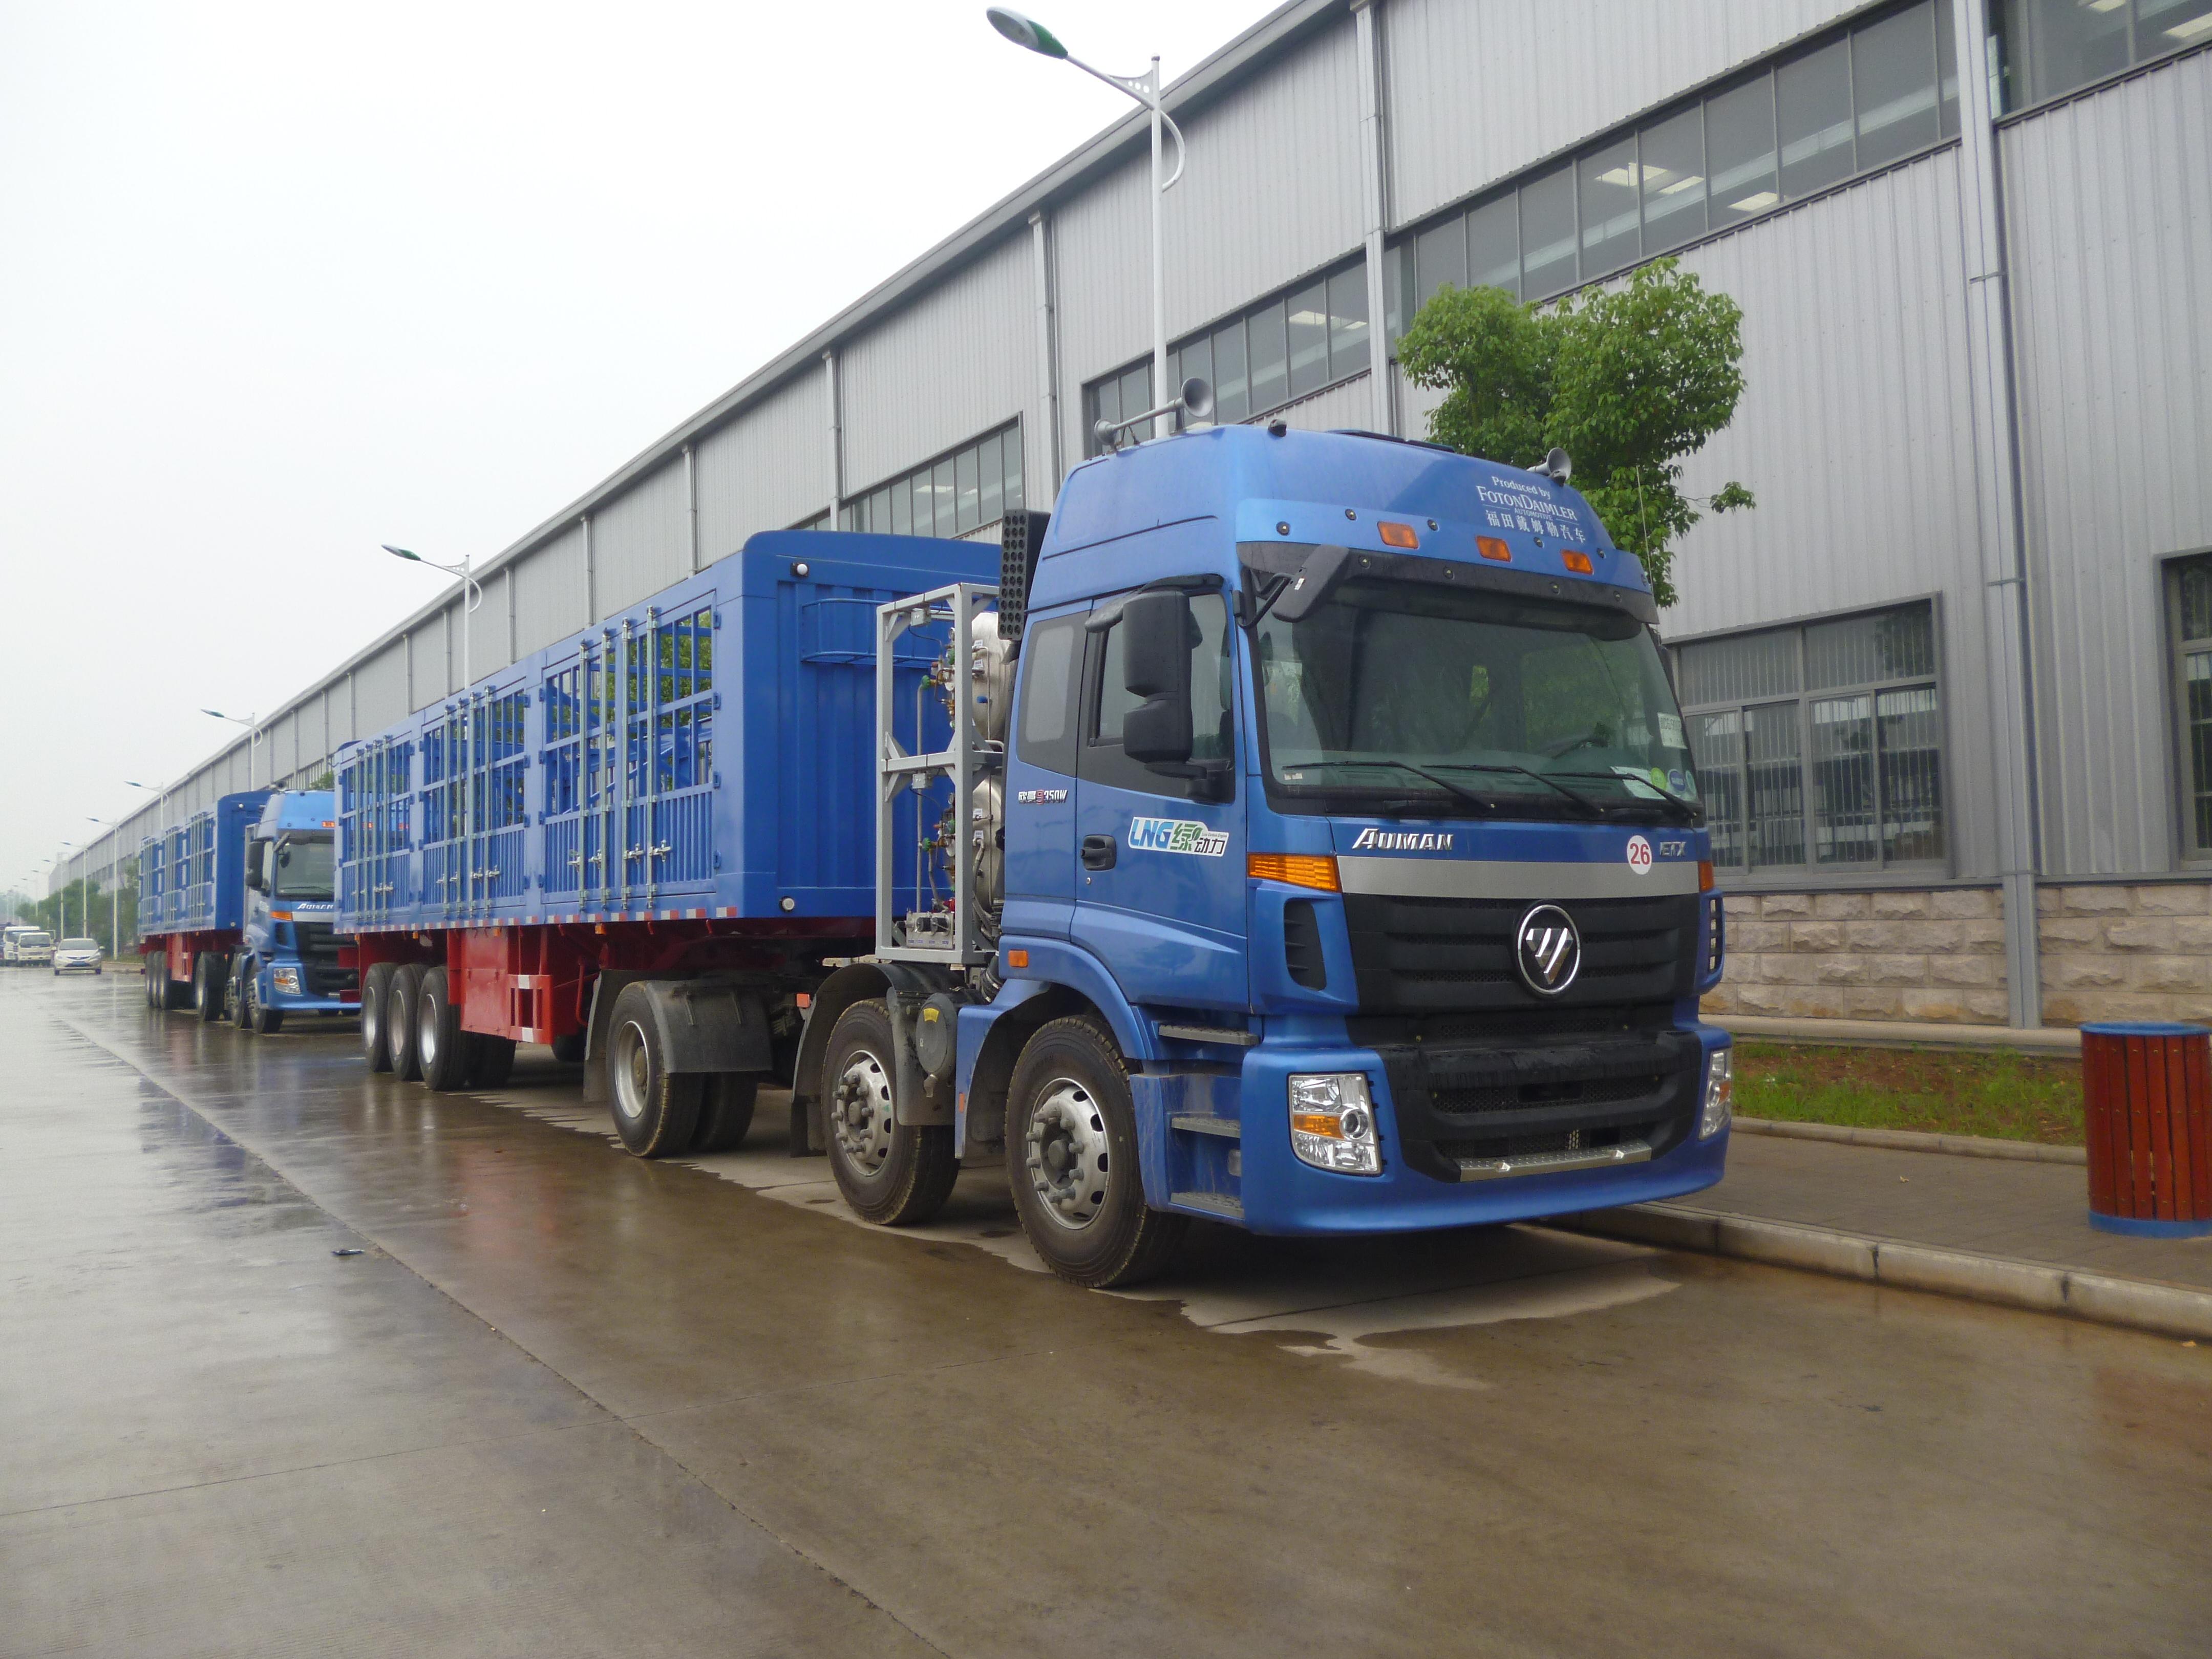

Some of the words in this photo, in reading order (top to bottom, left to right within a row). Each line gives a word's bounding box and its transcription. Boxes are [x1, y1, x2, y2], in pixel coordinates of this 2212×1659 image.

[1492, 476, 1538, 495] Produced
[1539, 487, 1551, 500] by
[1476, 485, 1578, 521] FOTONDAIMLER
[1514, 507, 1554, 521] AUTOMOTIVE
[1485, 509, 1586, 544] 福田戴姆勒汽车
[1130, 819, 1174, 849] LNG
[1352, 827, 1454, 850] AUMAN
[1630, 843, 1650, 865] 26
[1660, 841, 1687, 857] ETX
